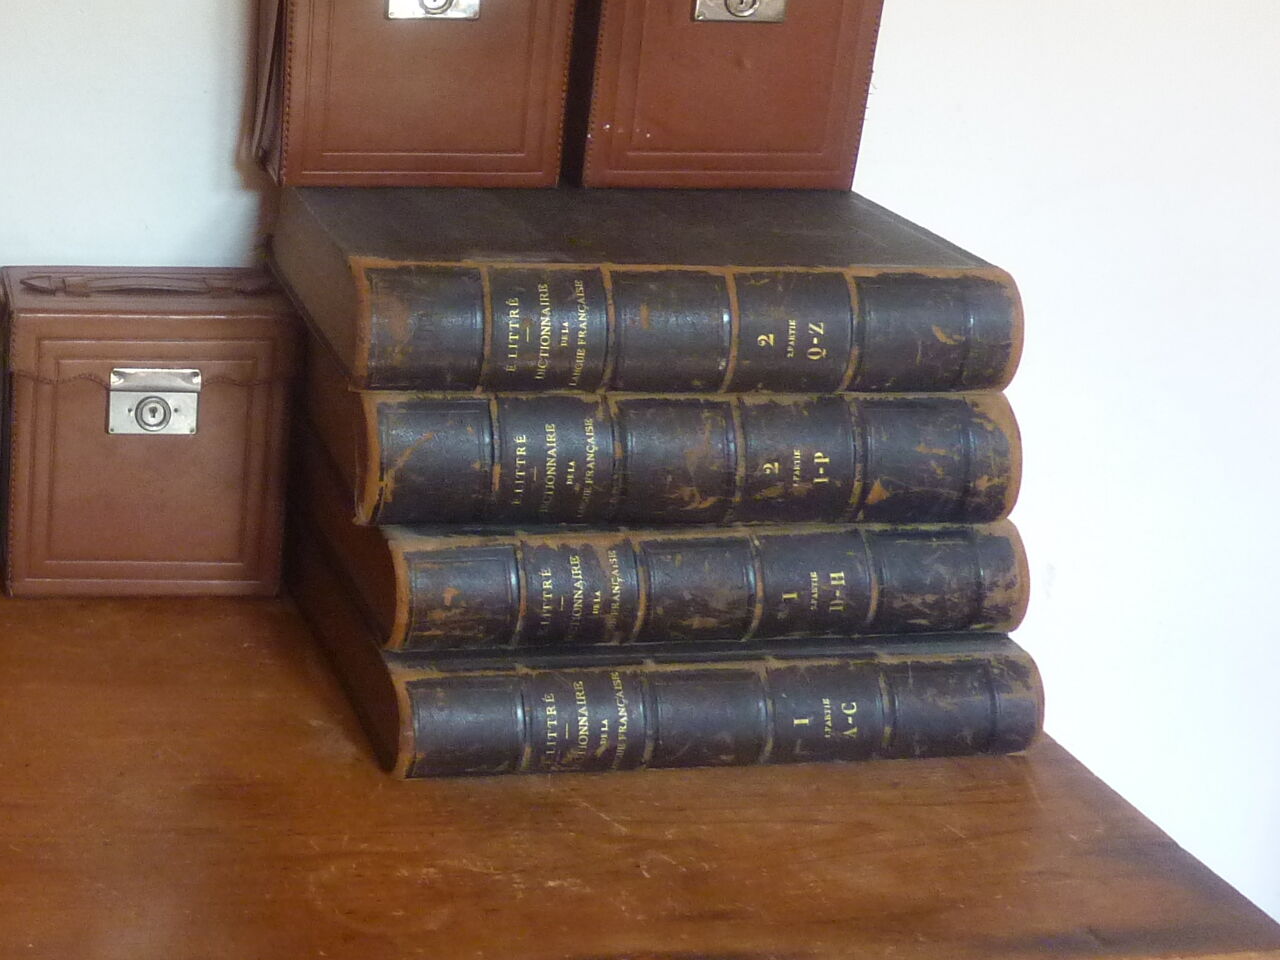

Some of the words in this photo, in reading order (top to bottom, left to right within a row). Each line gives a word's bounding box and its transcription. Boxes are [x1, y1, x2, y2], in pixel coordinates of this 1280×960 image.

[506, 297, 519, 358] LITTRÉ
[534, 283, 551, 379] DICTIONNAIRE
[575, 280, 589, 345] FRANÇAISE
[757, 333, 774, 347] 2
[513, 434, 526, 493] LITTRÉ
[584, 418, 598, 484] FRANÇAISE
[763, 462, 779, 474] 2
[610, 672, 628, 740] FRANÇAISE
